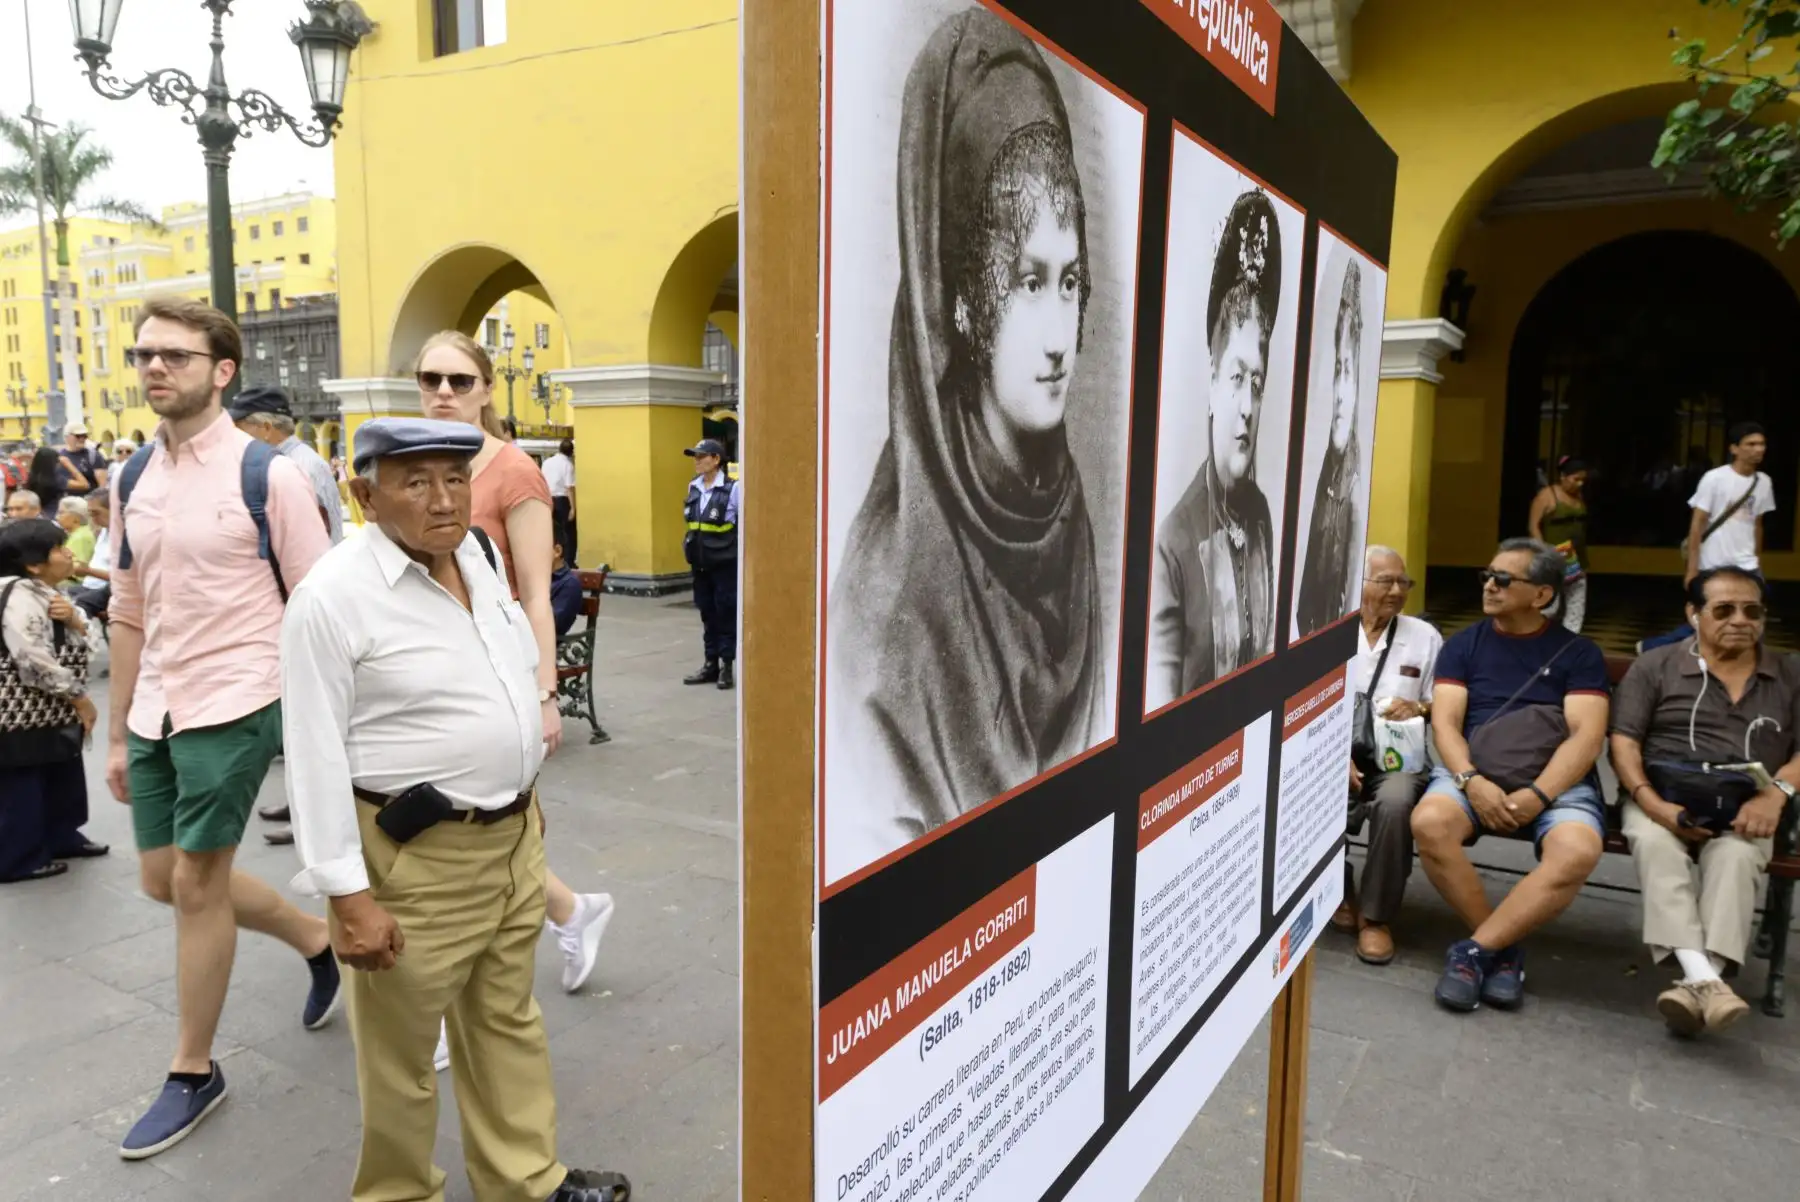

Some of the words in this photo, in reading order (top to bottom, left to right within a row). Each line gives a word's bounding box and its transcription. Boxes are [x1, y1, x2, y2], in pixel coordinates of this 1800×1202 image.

[1141, 790, 1180, 830] CLORINDA
[1181, 773, 1204, 801] MATTO
[1205, 766, 1214, 784] DE
[1215, 749, 1238, 776] TURNER
[827, 997, 892, 1064] JUANA
[896, 938, 971, 1012] MANUELA
[975, 896, 1027, 951] GORRITI
[919, 1010, 963, 1062] (Salta,
[968, 947, 1031, 1014] 1818-1892)
[838, 1125, 900, 1201] Desarrolló
[902, 1115, 915, 1139] su
[918, 1078, 954, 1124] carrera
[956, 1045, 990, 1088] literaria
[991, 1033, 1002, 1054] en
[1004, 1009, 1025, 1042] Perú,
[1027, 1001, 1037, 1020] en
[1038, 978, 1062, 1009] donde
[1063, 948, 1092, 987] inauguró
[1091, 946, 1098, 964] y
[897, 1151, 913, 1180] las
[919, 1102, 962, 1162] primeras
[1048, 1002, 1064, 1031] para
[1068, 974, 1096, 1008] mujeres,
[936, 1152, 975, 1201] veladas,
[978, 1109, 1011, 1156] además
[1014, 1096, 1024, 1115] de
[1027, 1080, 1038, 1102] los
[1040, 1056, 1062, 1087] textos
[946, 1131, 964, 1161] que
[967, 1102, 992, 1138] hasta
[994, 1083, 1010, 1108] ese
[1012, 1044, 1048, 1090] momento
[1050, 1030, 1062, 1051] era
[1064, 1014, 1079, 1037] solo
[1080, 997, 1096, 1025] para
[965, 1148, 1001, 1202] políticos
[1003, 1108, 1037, 1155] referidos
[1039, 1100, 1044, 1115] a
[1046, 1091, 1053, 1107] la
[1054, 1057, 1085, 1099] situación
[1086, 1047, 1094, 1064] de
